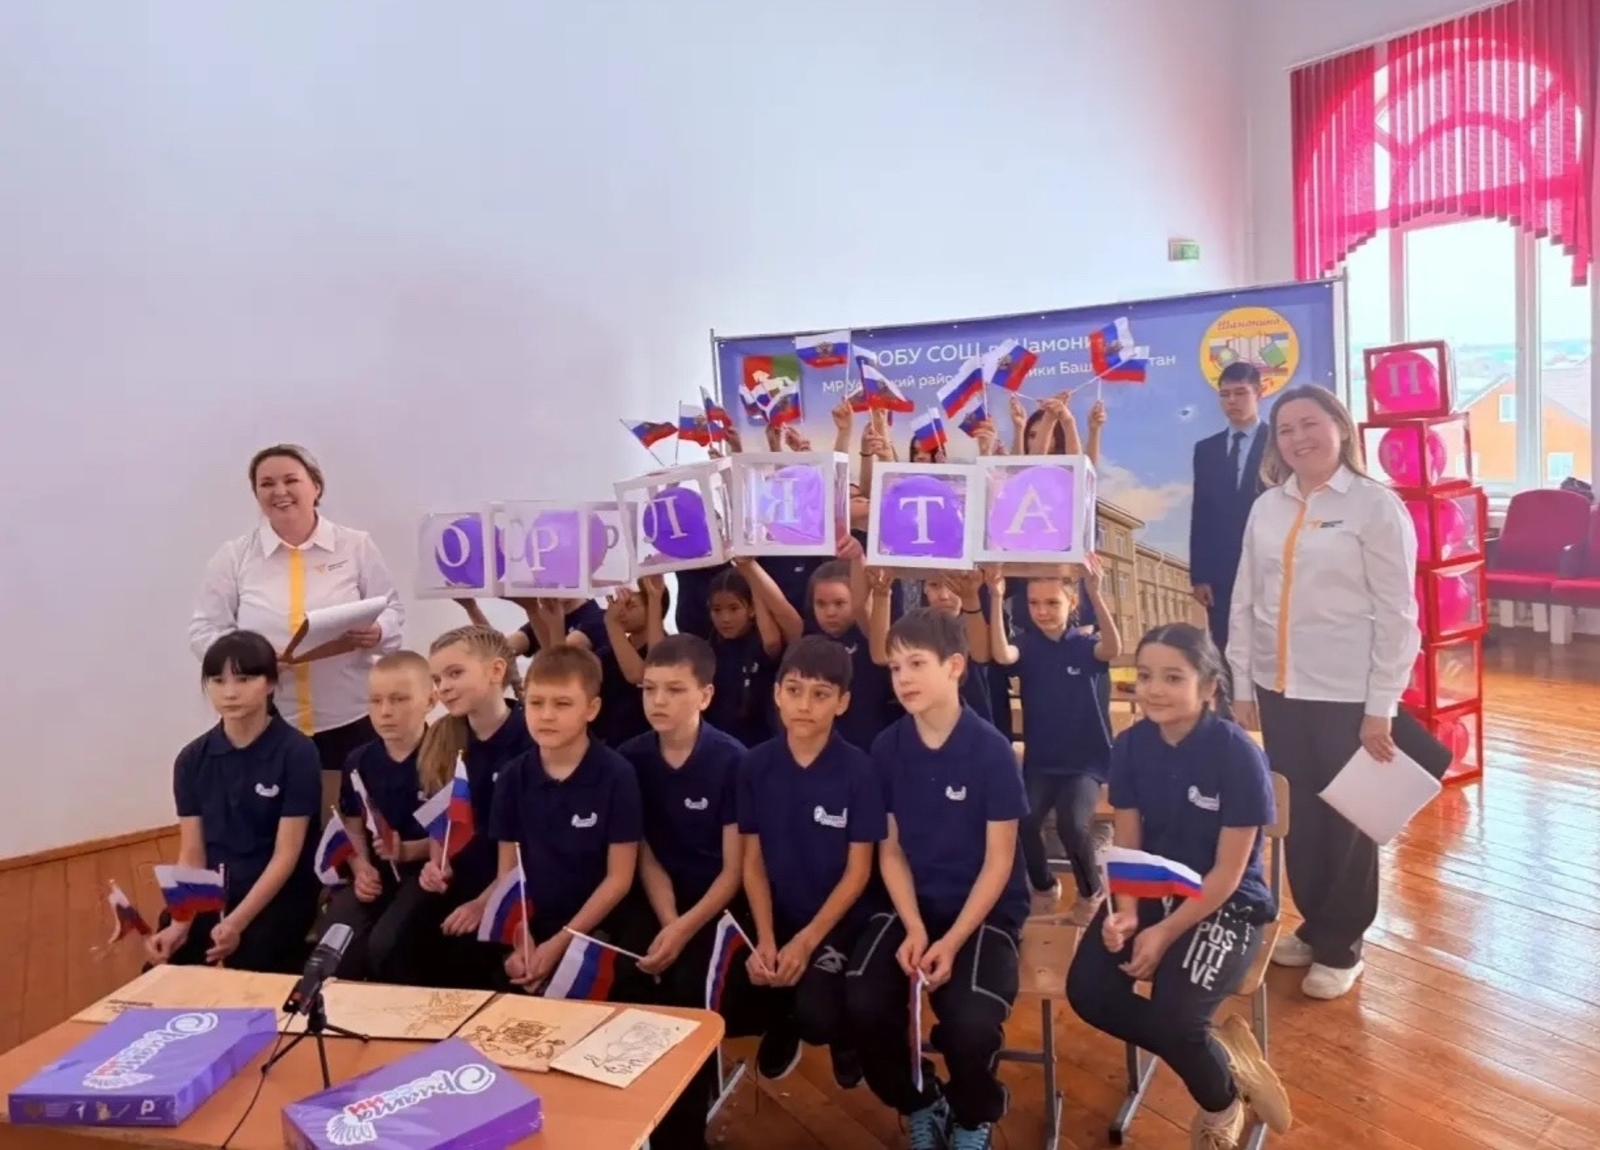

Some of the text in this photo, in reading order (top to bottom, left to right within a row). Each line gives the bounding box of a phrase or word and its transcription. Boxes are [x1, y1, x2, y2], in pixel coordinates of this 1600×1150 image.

[875, 346, 923, 367] ОБУ
[926, 342, 980, 363] СОШ
[822, 380, 845, 393] МР
[919, 372, 954, 389] райо
